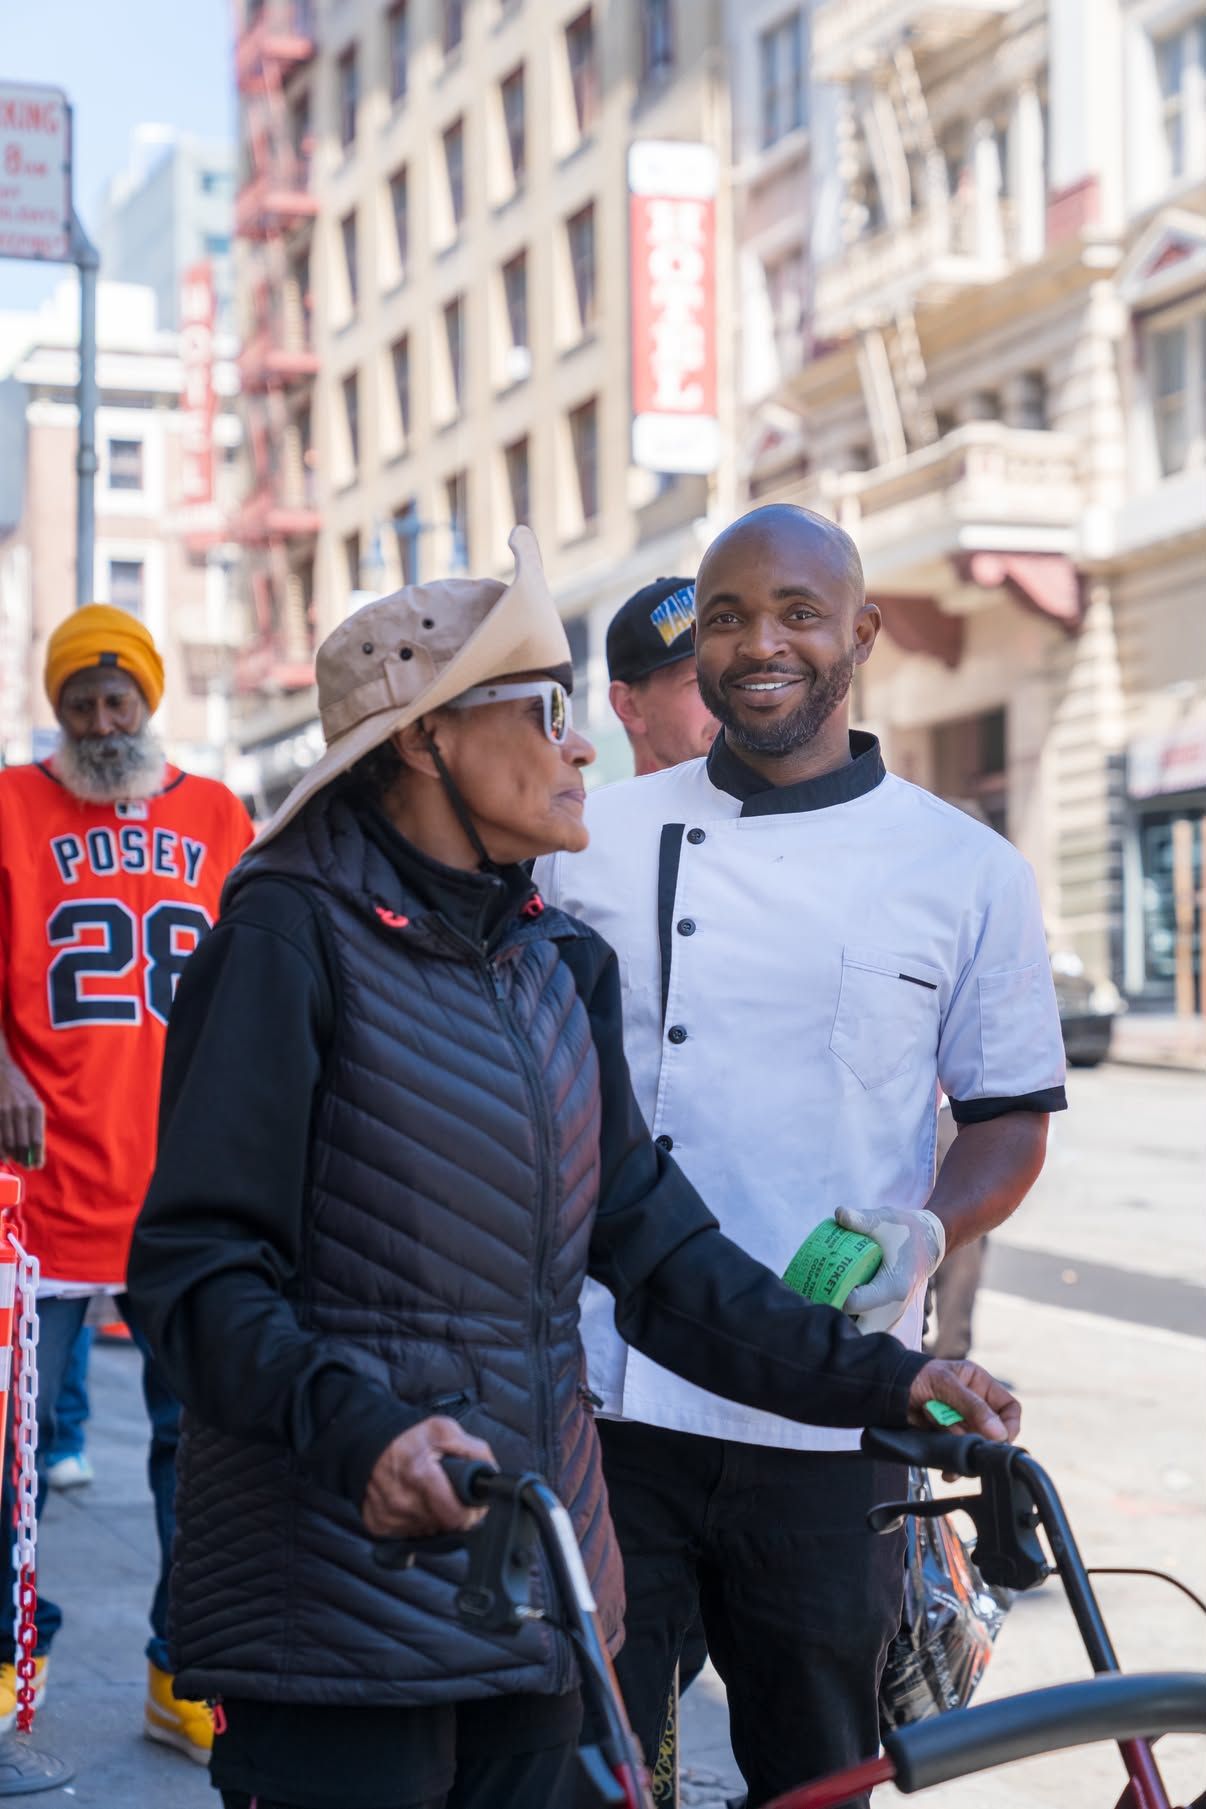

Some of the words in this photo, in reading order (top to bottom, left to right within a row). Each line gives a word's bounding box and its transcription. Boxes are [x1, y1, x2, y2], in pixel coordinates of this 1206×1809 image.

[0, 99, 59, 133] KING
[647, 199, 706, 409] HOTEL
[649, 584, 696, 648] WAR
[50, 825, 206, 888] POSEY
[47, 898, 214, 1029] 28
[802, 1258, 819, 1295] COUPON
[823, 1256, 853, 1295] TICKET
